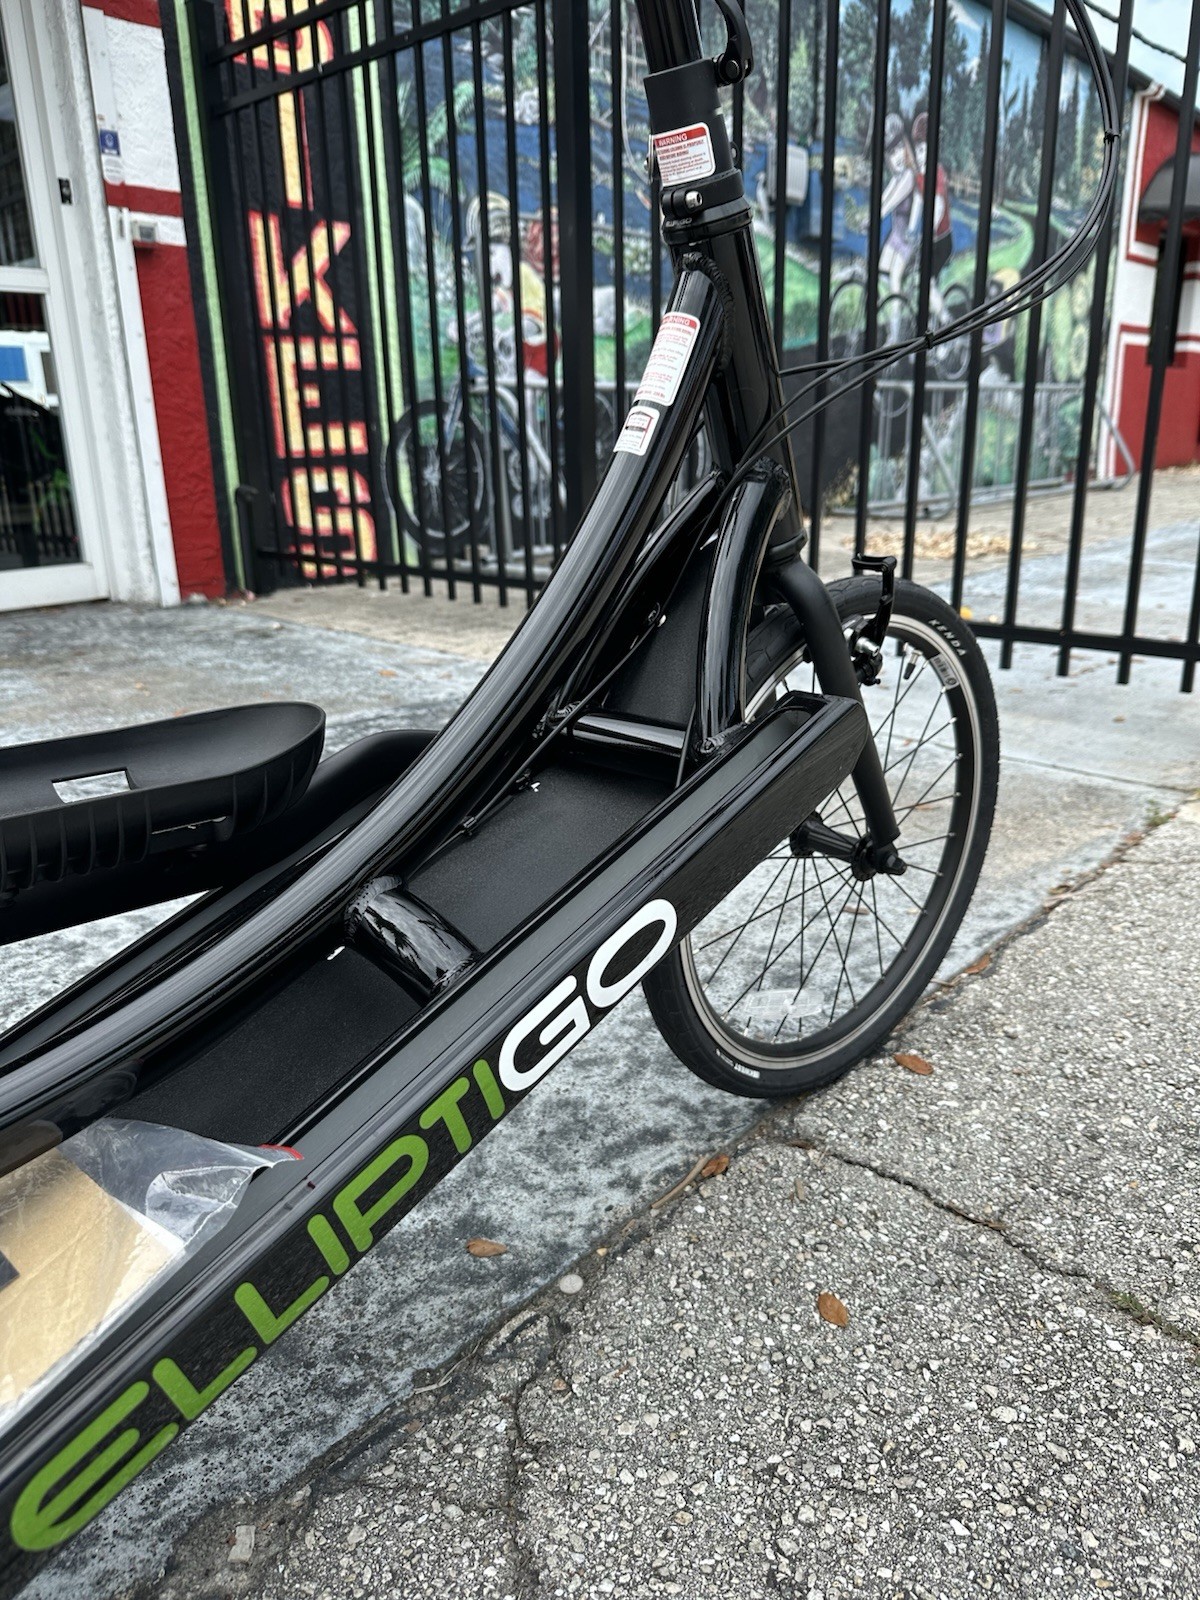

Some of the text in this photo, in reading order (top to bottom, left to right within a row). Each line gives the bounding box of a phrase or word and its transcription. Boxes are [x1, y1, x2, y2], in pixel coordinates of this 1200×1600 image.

[658, 133, 688, 147] WARNING
[928, 619, 967, 656] KENDA
[11, 899, 677, 1549] ELLIPTIGO
